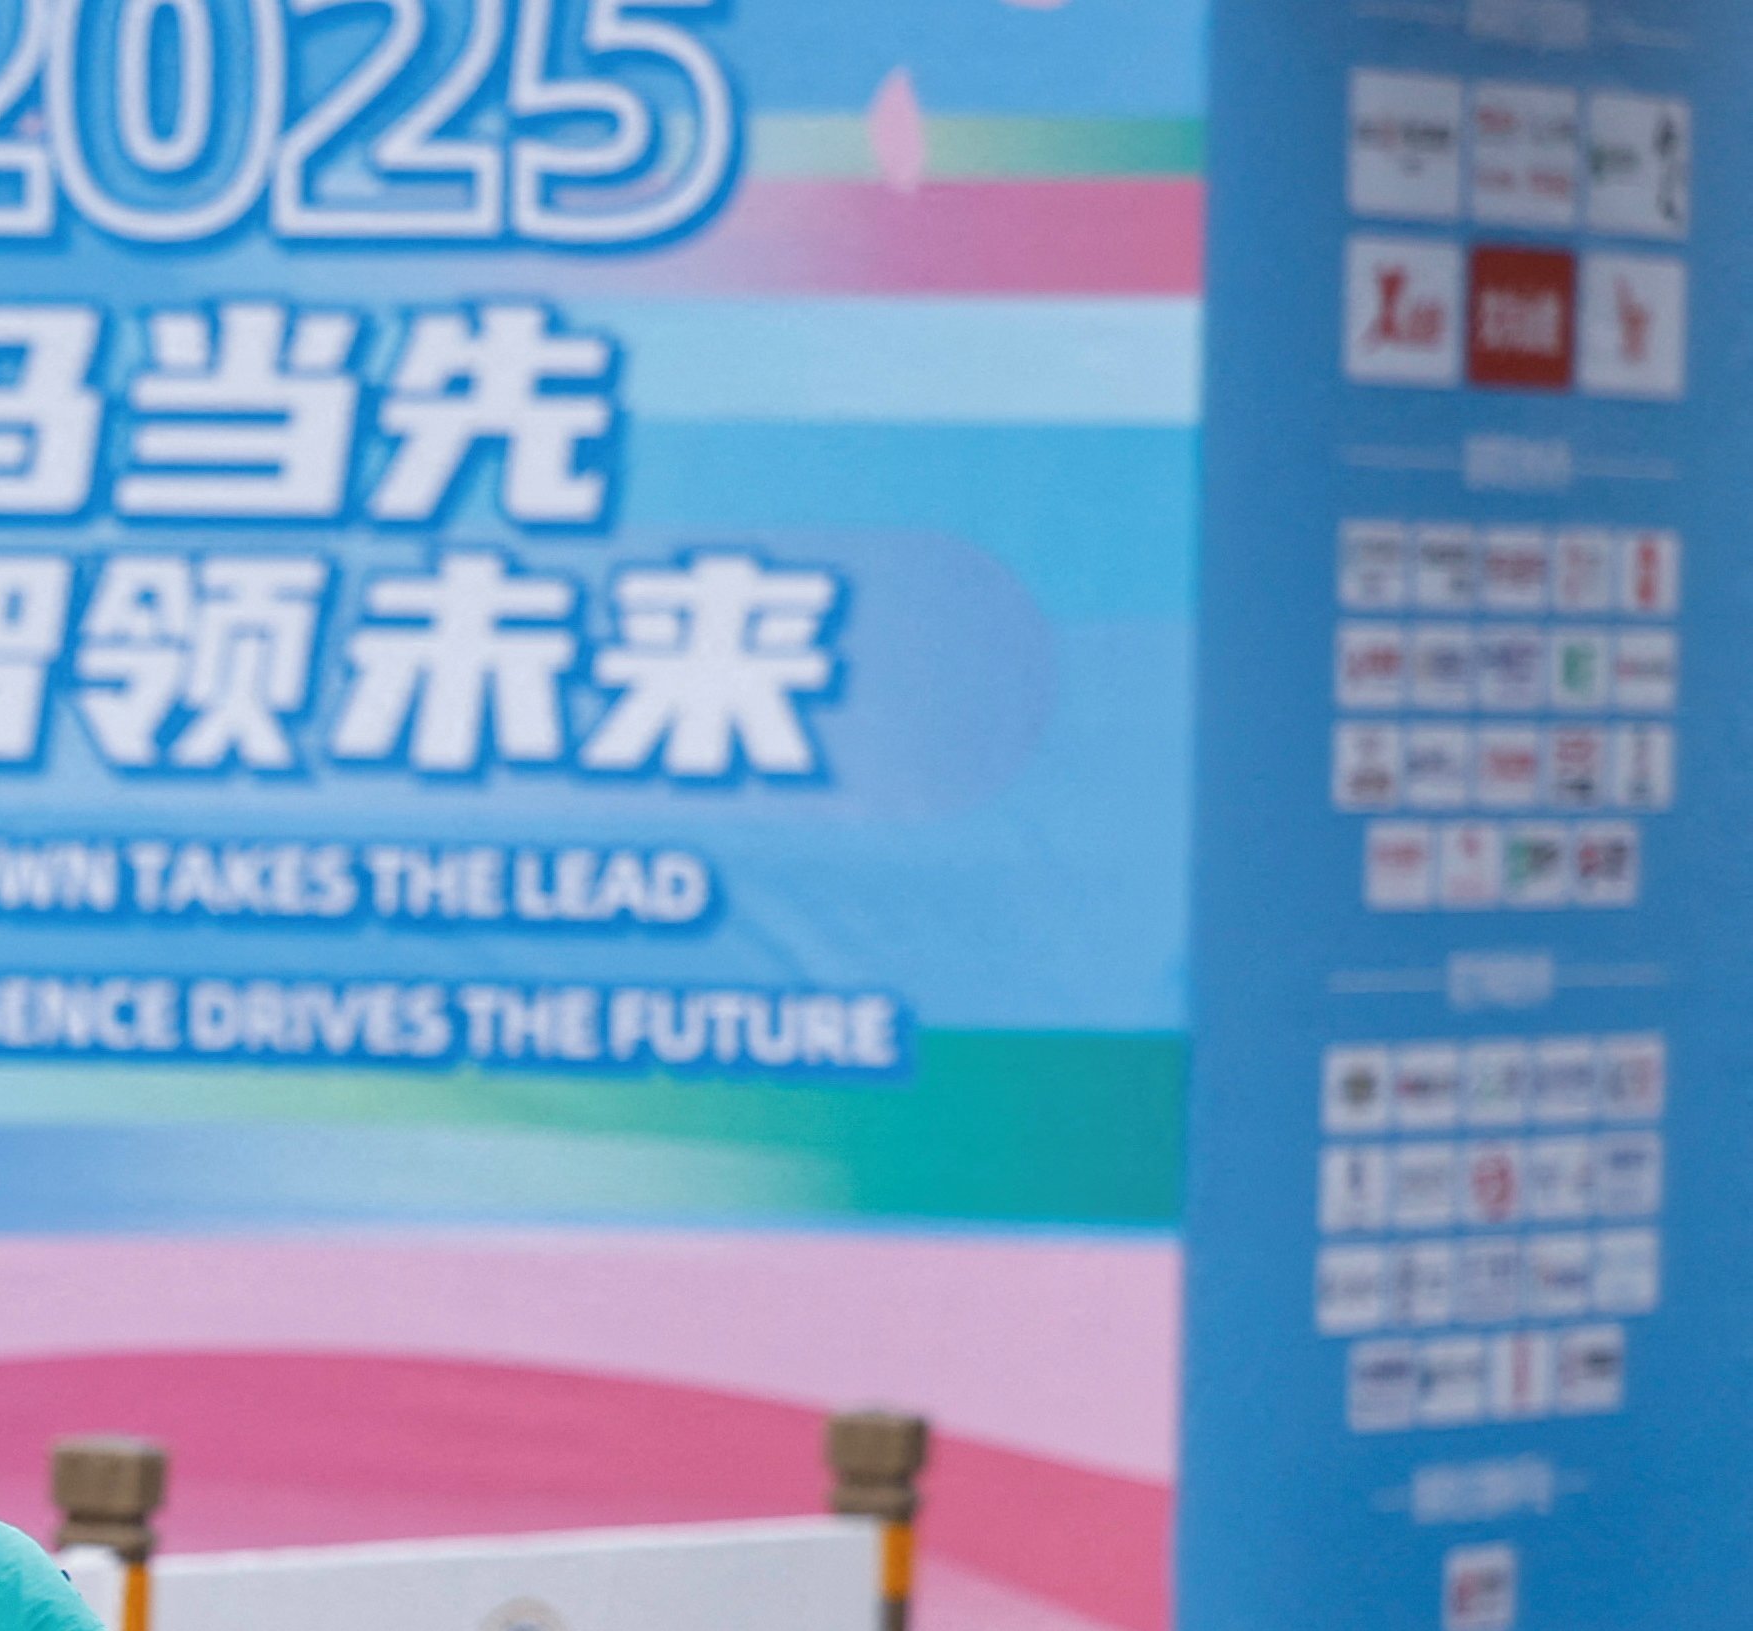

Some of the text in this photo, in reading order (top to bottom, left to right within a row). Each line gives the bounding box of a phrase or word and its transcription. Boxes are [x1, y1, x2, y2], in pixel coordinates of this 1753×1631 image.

[128, 842, 355, 917] TAKES
[366, 848, 504, 919] THE
[515, 850, 707, 921] LEAD
[185, 978, 452, 1057] DRIVES
[455, 985, 601, 1062] THE
[609, 990, 897, 1068] FUTURE
